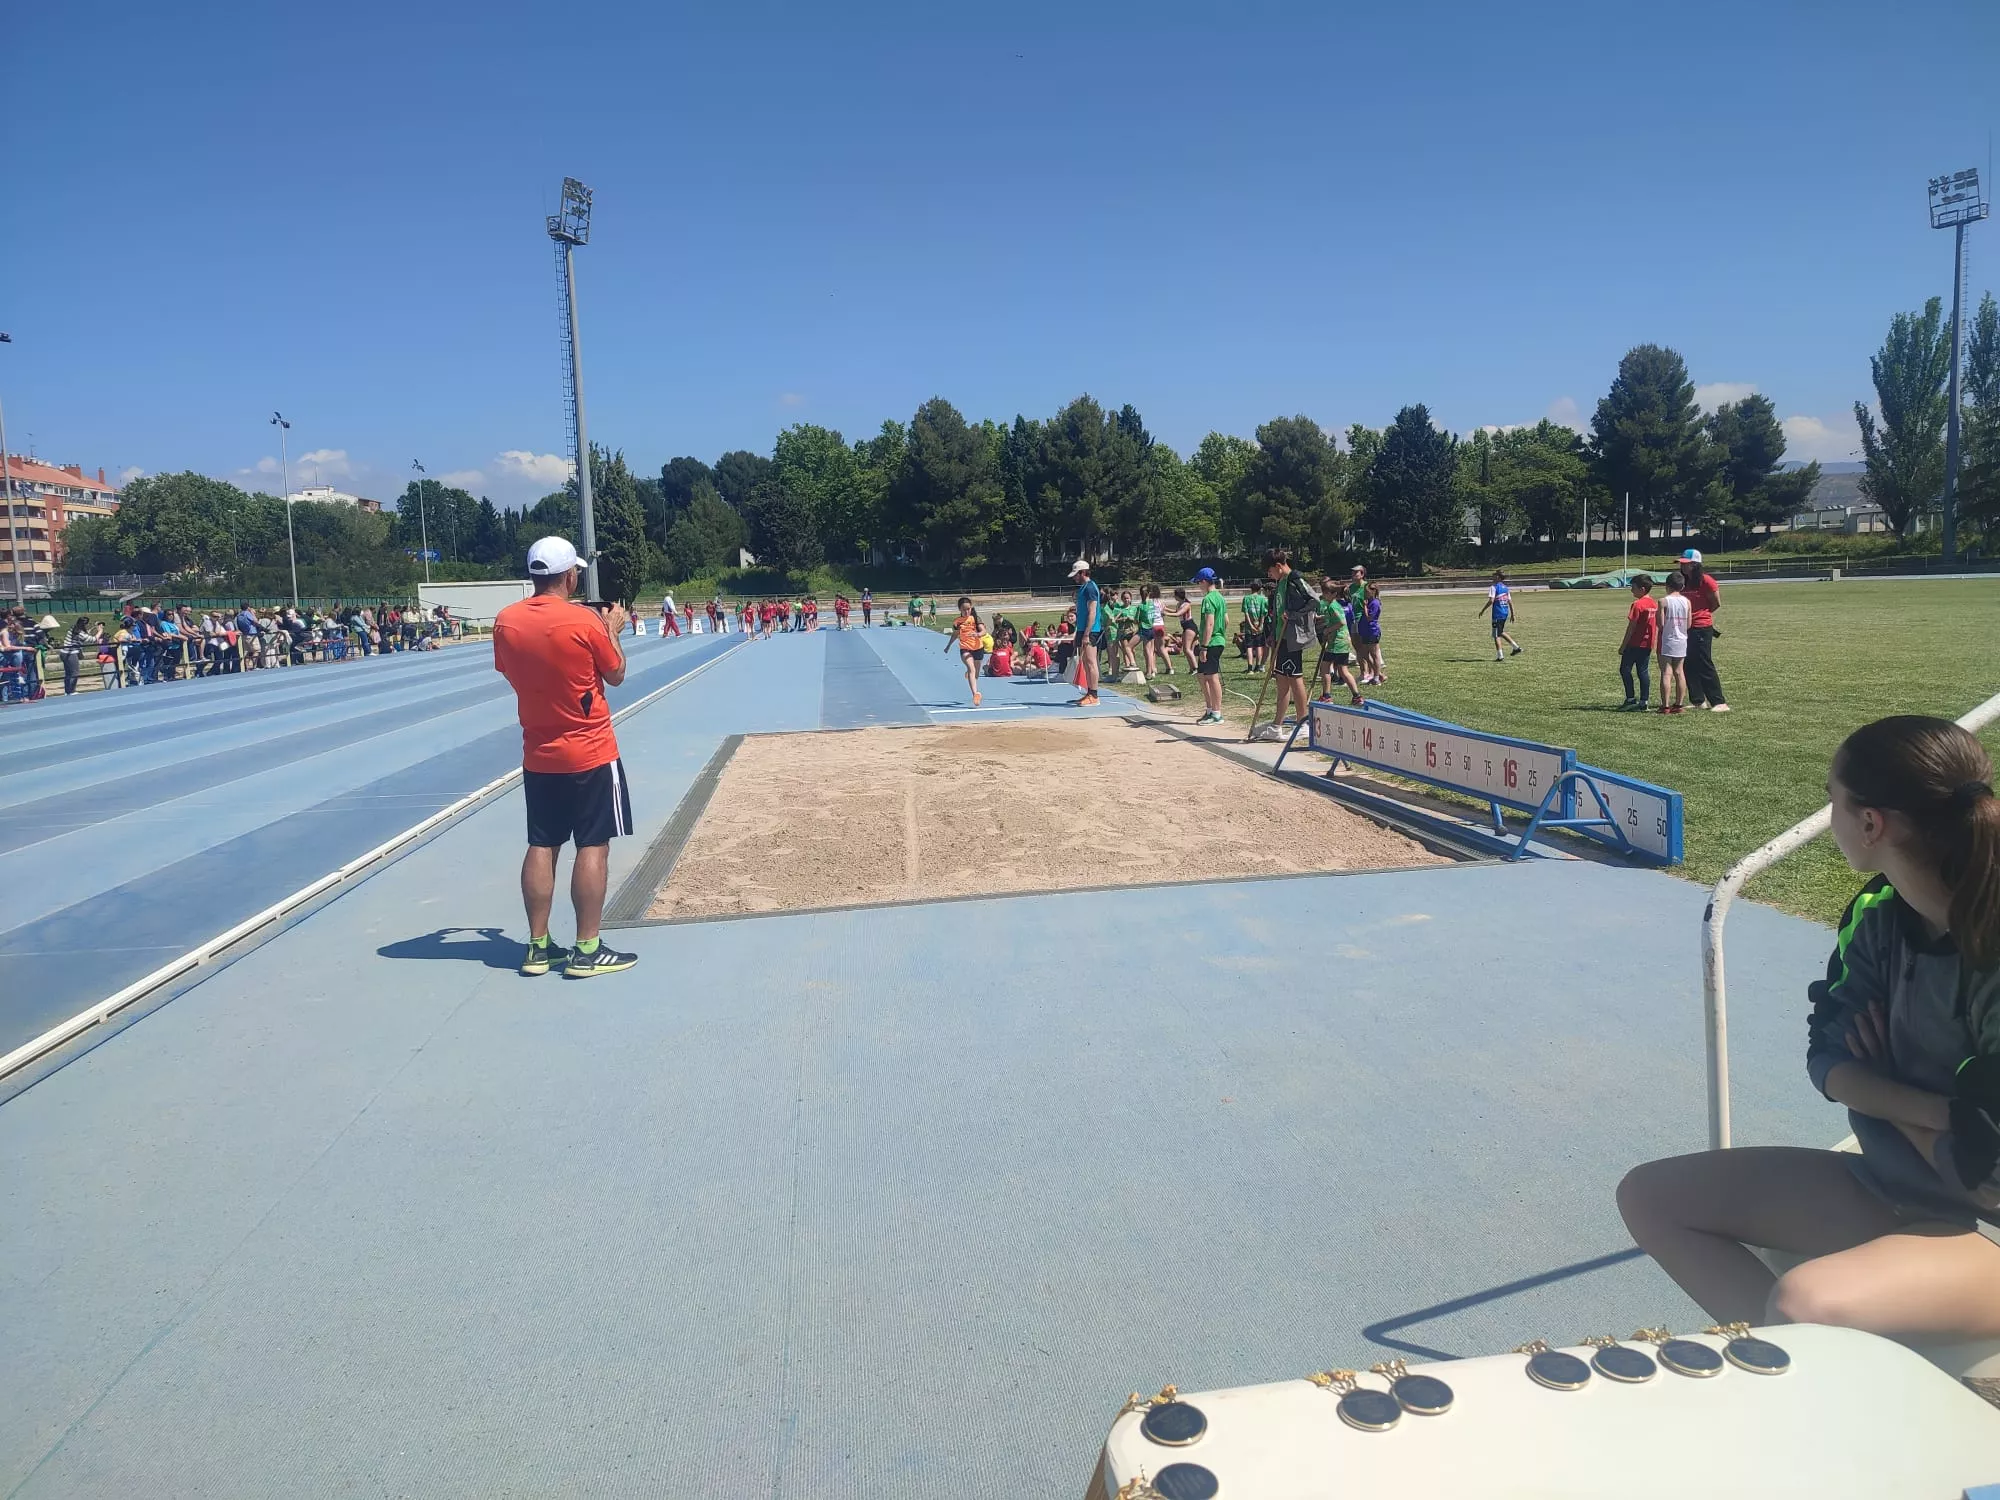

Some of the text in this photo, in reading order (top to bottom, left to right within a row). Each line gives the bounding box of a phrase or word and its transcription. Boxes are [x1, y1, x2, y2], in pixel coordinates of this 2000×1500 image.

[638, 624, 644, 632] 5
[695, 622, 700, 631] 3
[1362, 727, 1372, 752] 14
[1379, 735, 1385, 750] 25
[1393, 739, 1401, 754] 50
[1410, 743, 1417, 758] 75
[1425, 741, 1437, 768] 15
[1444, 751, 1452, 767] 25
[1463, 755, 1472, 771] 50
[1484, 760, 1492, 777] 75
[1503, 758, 1518, 788] 16
[1528, 769, 1537, 787] 25
[1627, 807, 1638, 826] 25
[1656, 817, 1667, 837] 50
